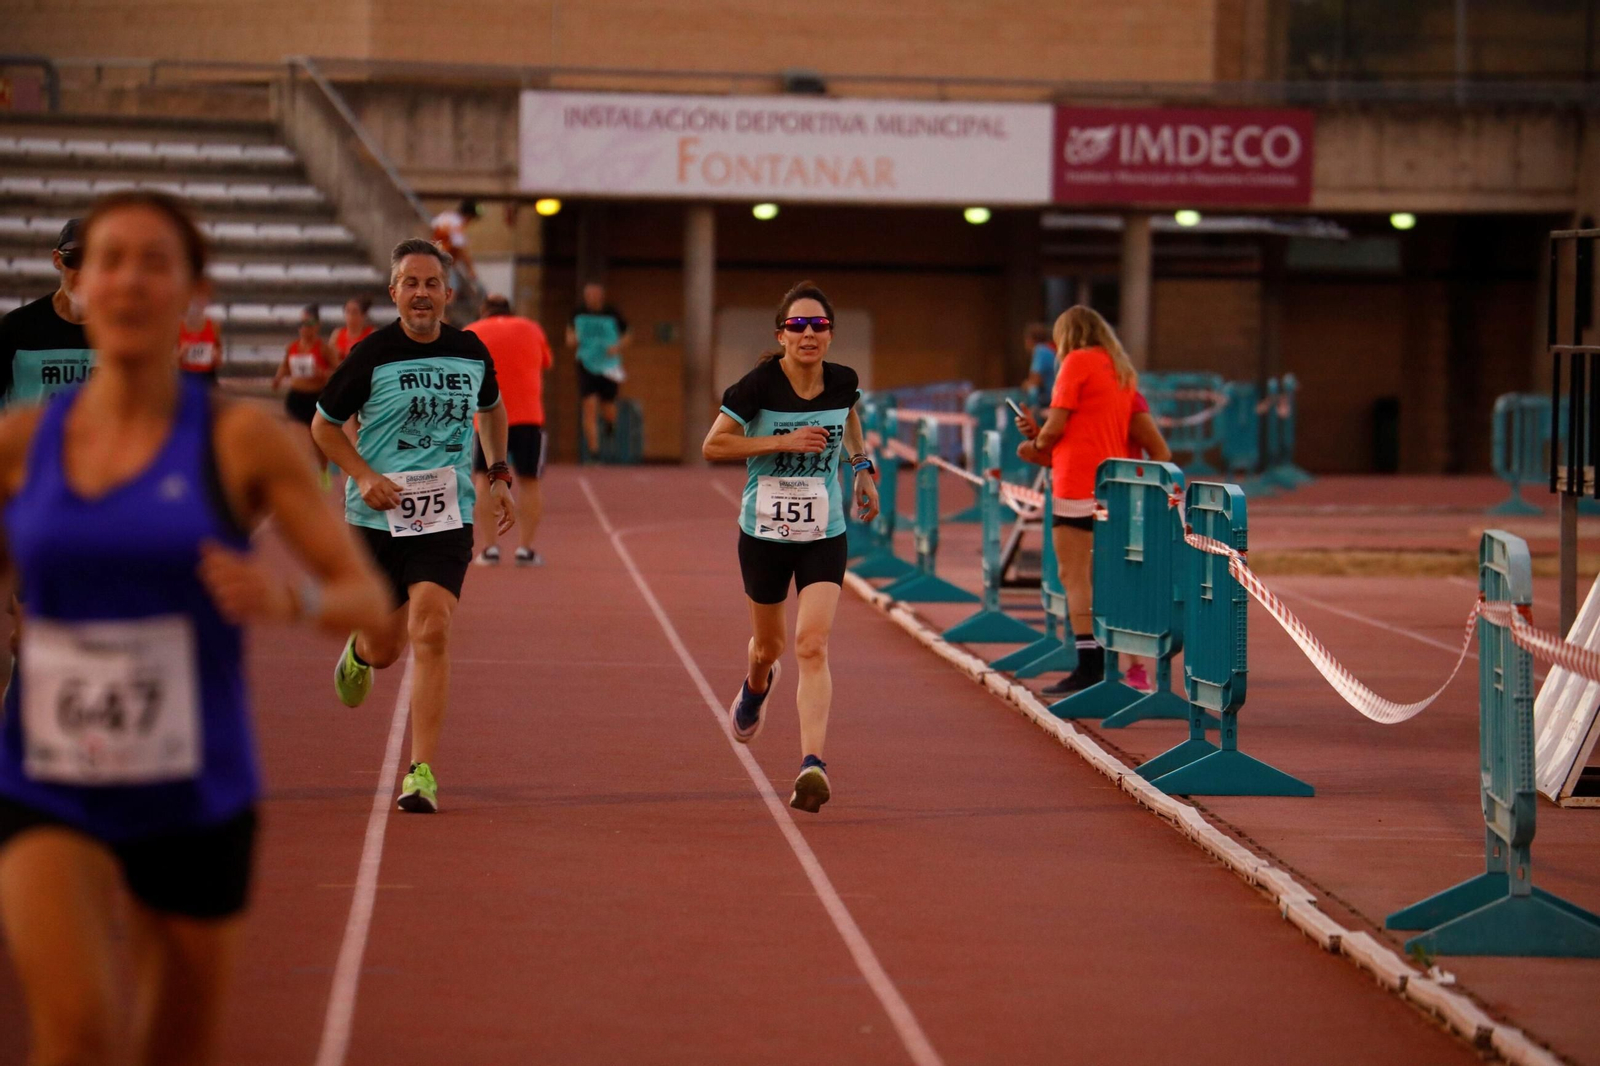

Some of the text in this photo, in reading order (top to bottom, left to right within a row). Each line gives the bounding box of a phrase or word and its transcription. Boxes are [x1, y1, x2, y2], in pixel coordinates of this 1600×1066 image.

[563, 104, 1007, 142] INSTALACIÓN DEPORTIVA MUNICIPAL
[1119, 124, 1302, 168] IMDECO
[401, 493, 446, 519] 975
[772, 501, 816, 523] 151
[56, 672, 165, 737] 647
